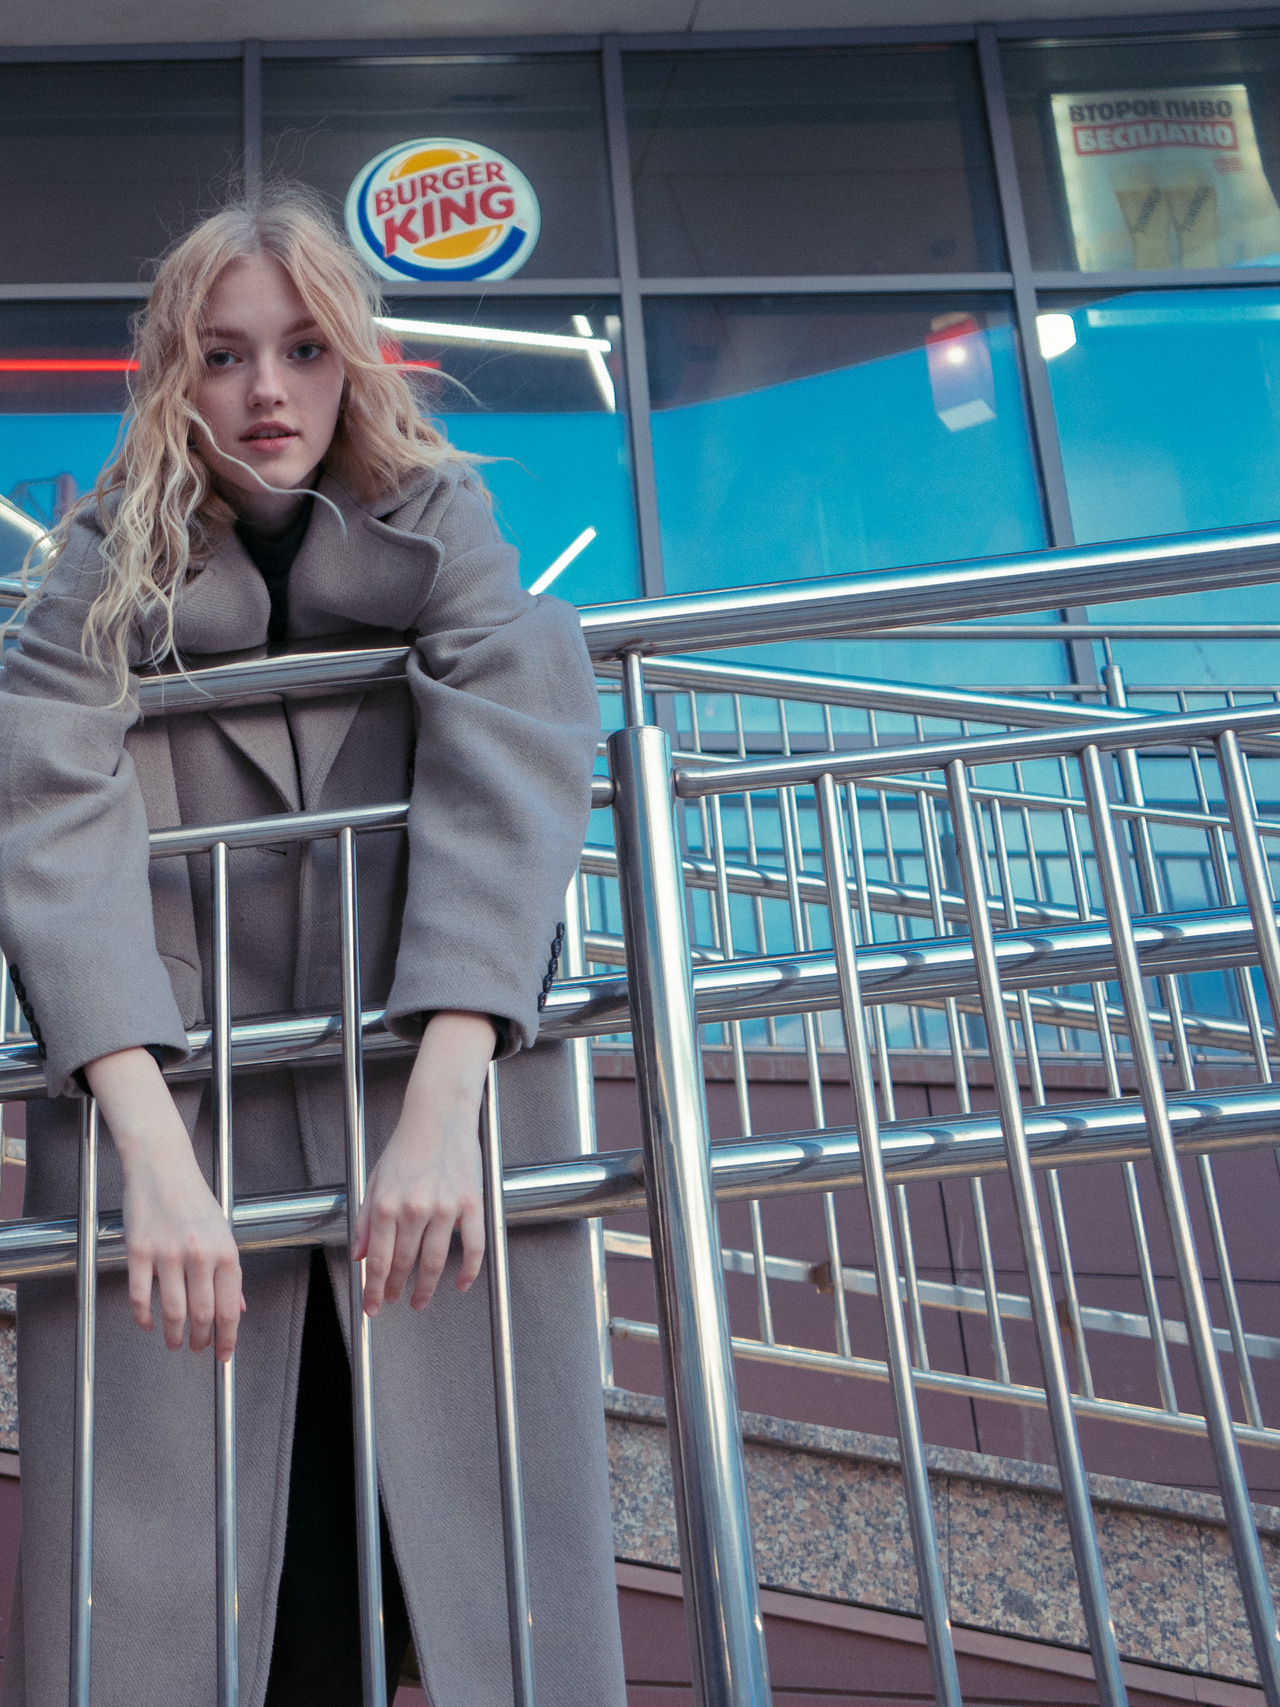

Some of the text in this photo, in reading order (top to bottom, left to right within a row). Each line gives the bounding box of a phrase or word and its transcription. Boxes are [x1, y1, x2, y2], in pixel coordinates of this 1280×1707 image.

[1070, 99, 1233, 122] ВТОРОЕ ПИВО
[1076, 122, 1234, 150] БЕСПЛАТНО
[375, 161, 507, 217] BURGER
[383, 185, 516, 258] KING
